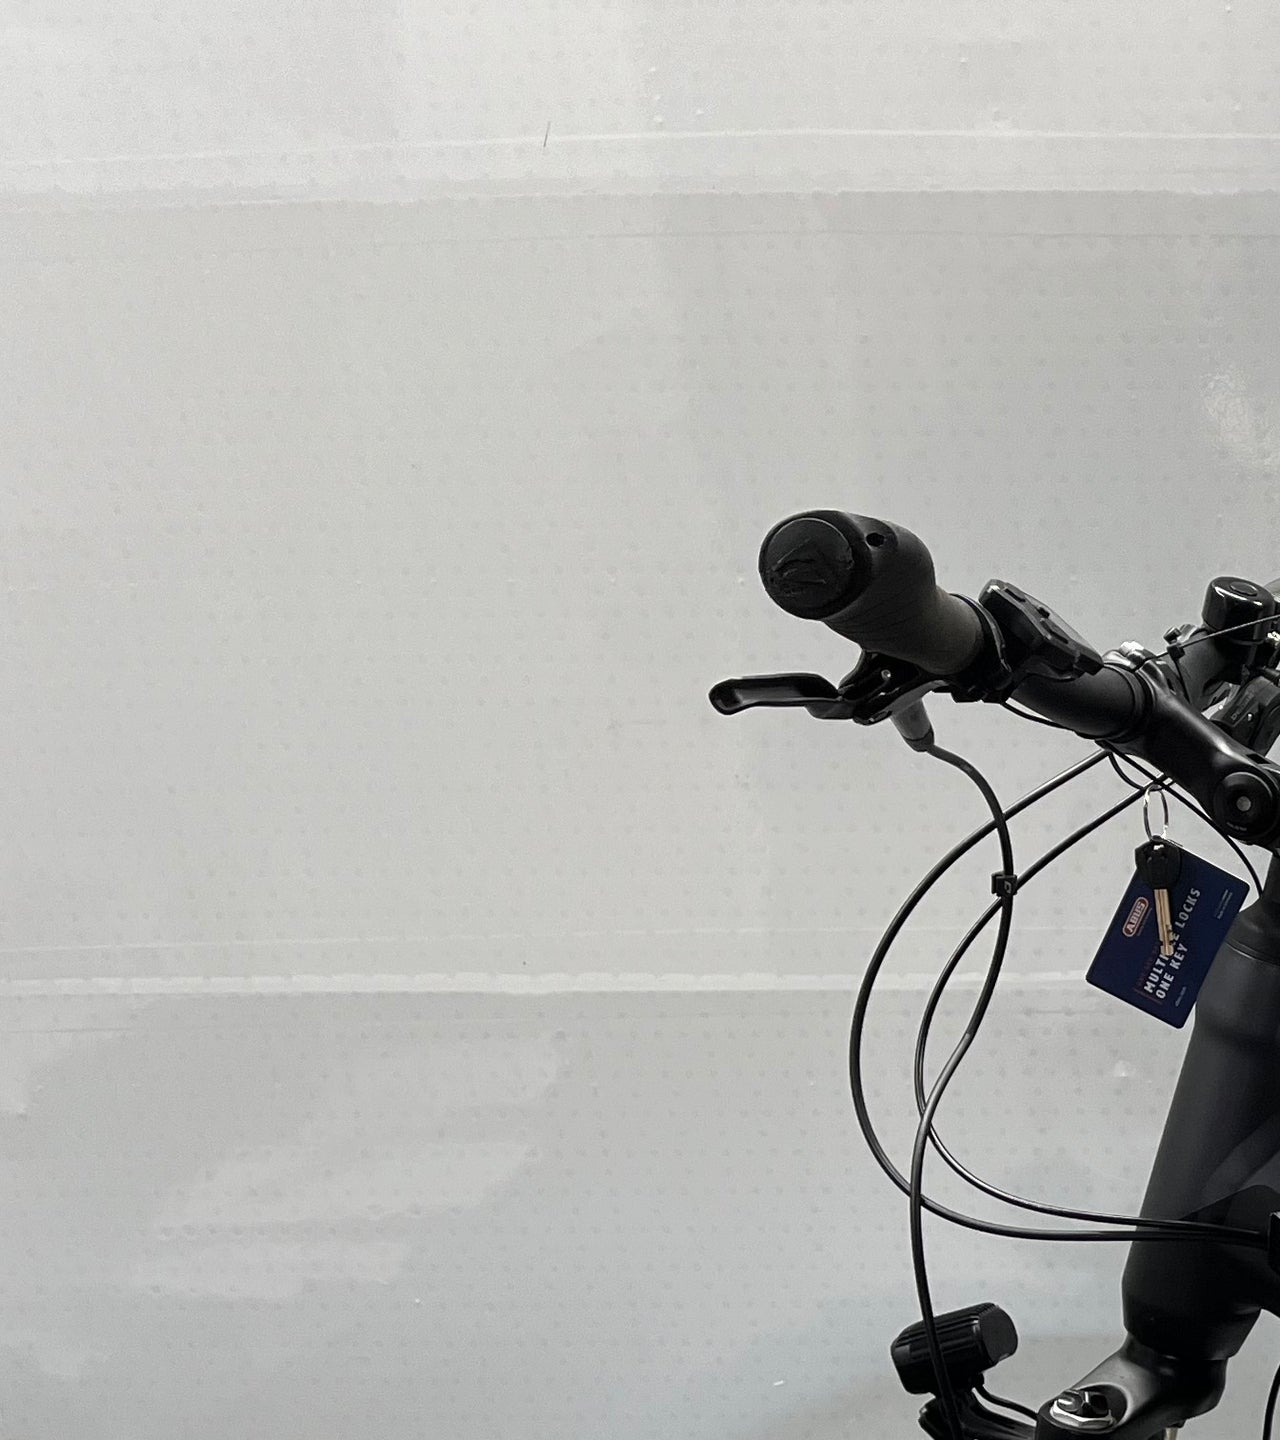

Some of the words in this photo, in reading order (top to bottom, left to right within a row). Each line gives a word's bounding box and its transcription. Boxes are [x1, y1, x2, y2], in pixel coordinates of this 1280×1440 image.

[1126, 900, 1146, 933] ABUS
[1144, 931, 1180, 993] MULTIE
[1175, 888, 1201, 929] LOCKS
[1155, 972, 1175, 999] ONE
[1170, 944, 1189, 970] KEY
